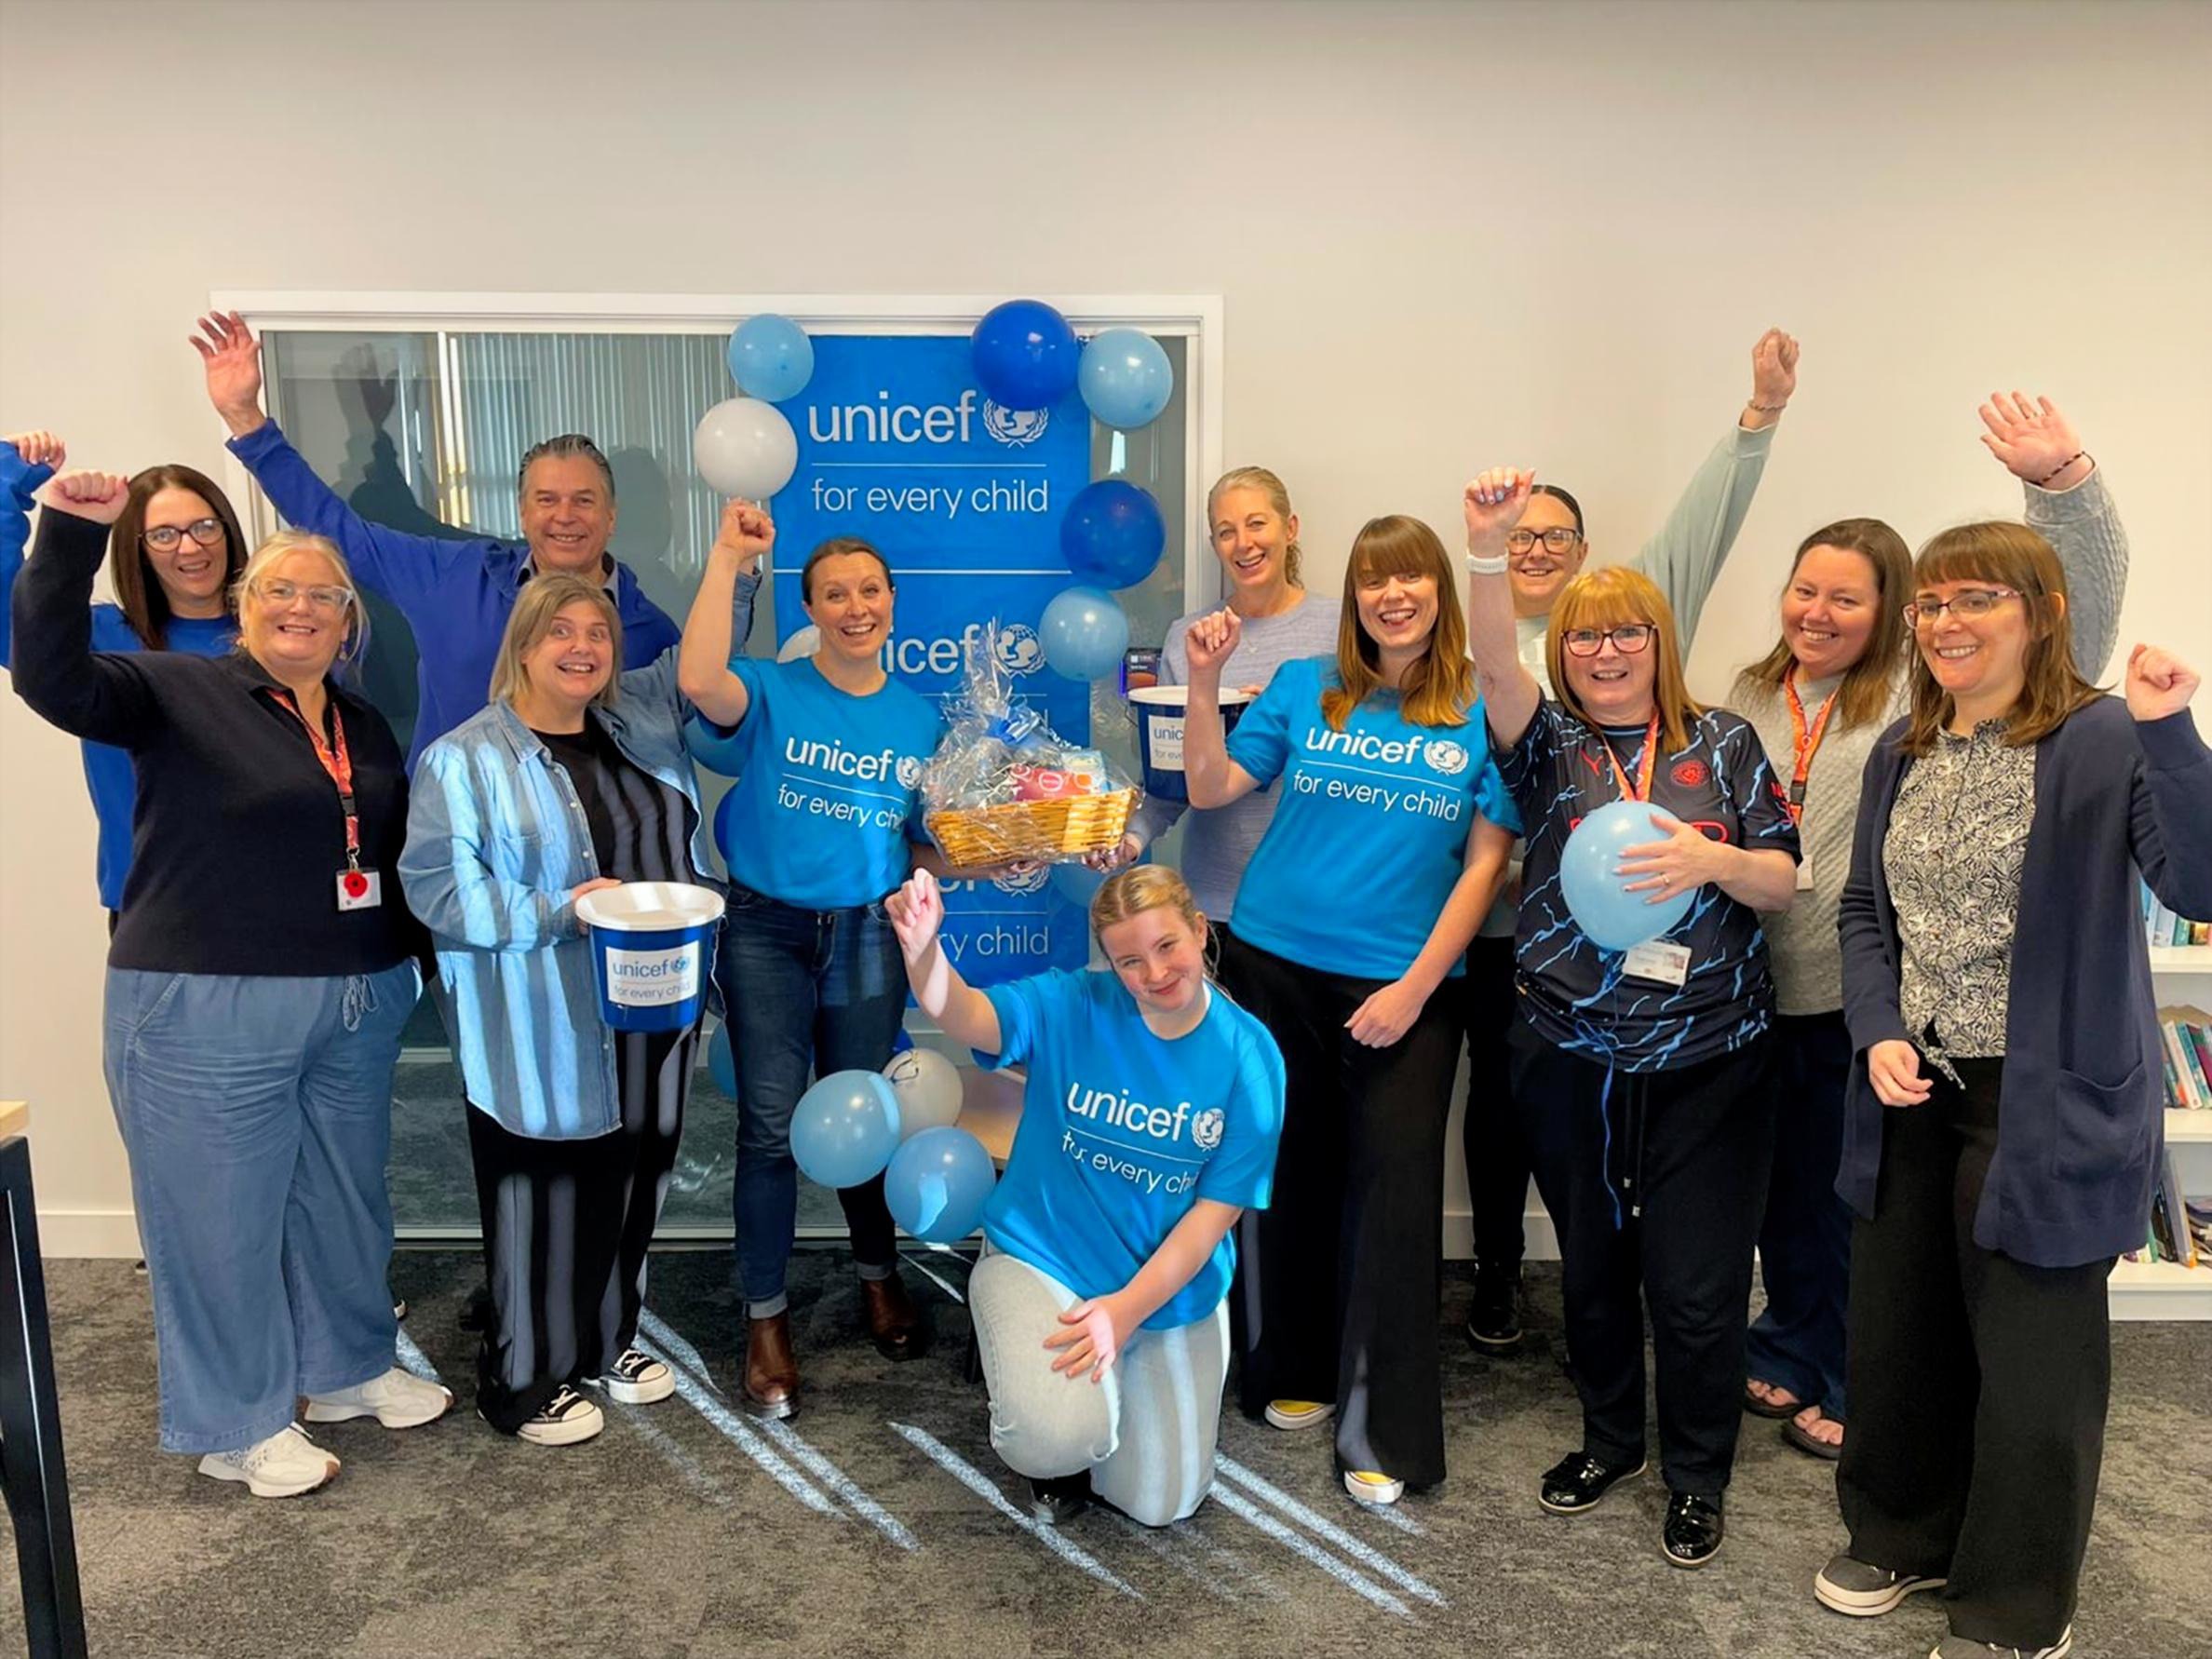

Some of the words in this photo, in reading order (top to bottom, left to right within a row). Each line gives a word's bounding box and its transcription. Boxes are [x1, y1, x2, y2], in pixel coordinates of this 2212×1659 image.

[808, 389, 976, 444] unicef
[812, 479, 857, 512] for
[867, 486, 964, 519] every
[971, 479, 1049, 512] child
[878, 624, 981, 674] icef
[1153, 724, 1184, 741] unic
[1305, 726, 1424, 764] unicef
[785, 736, 894, 782] unicef
[777, 783, 808, 810] for
[808, 797, 872, 828] every
[1292, 768, 1323, 794] for
[1327, 779, 1400, 810] every
[1402, 791, 1461, 822] child
[977, 925, 1048, 956] child
[613, 958, 670, 978] unicef
[629, 987, 665, 1000] every
[1066, 1081, 1192, 1142] unicef
[1092, 1152, 1164, 1194] every
